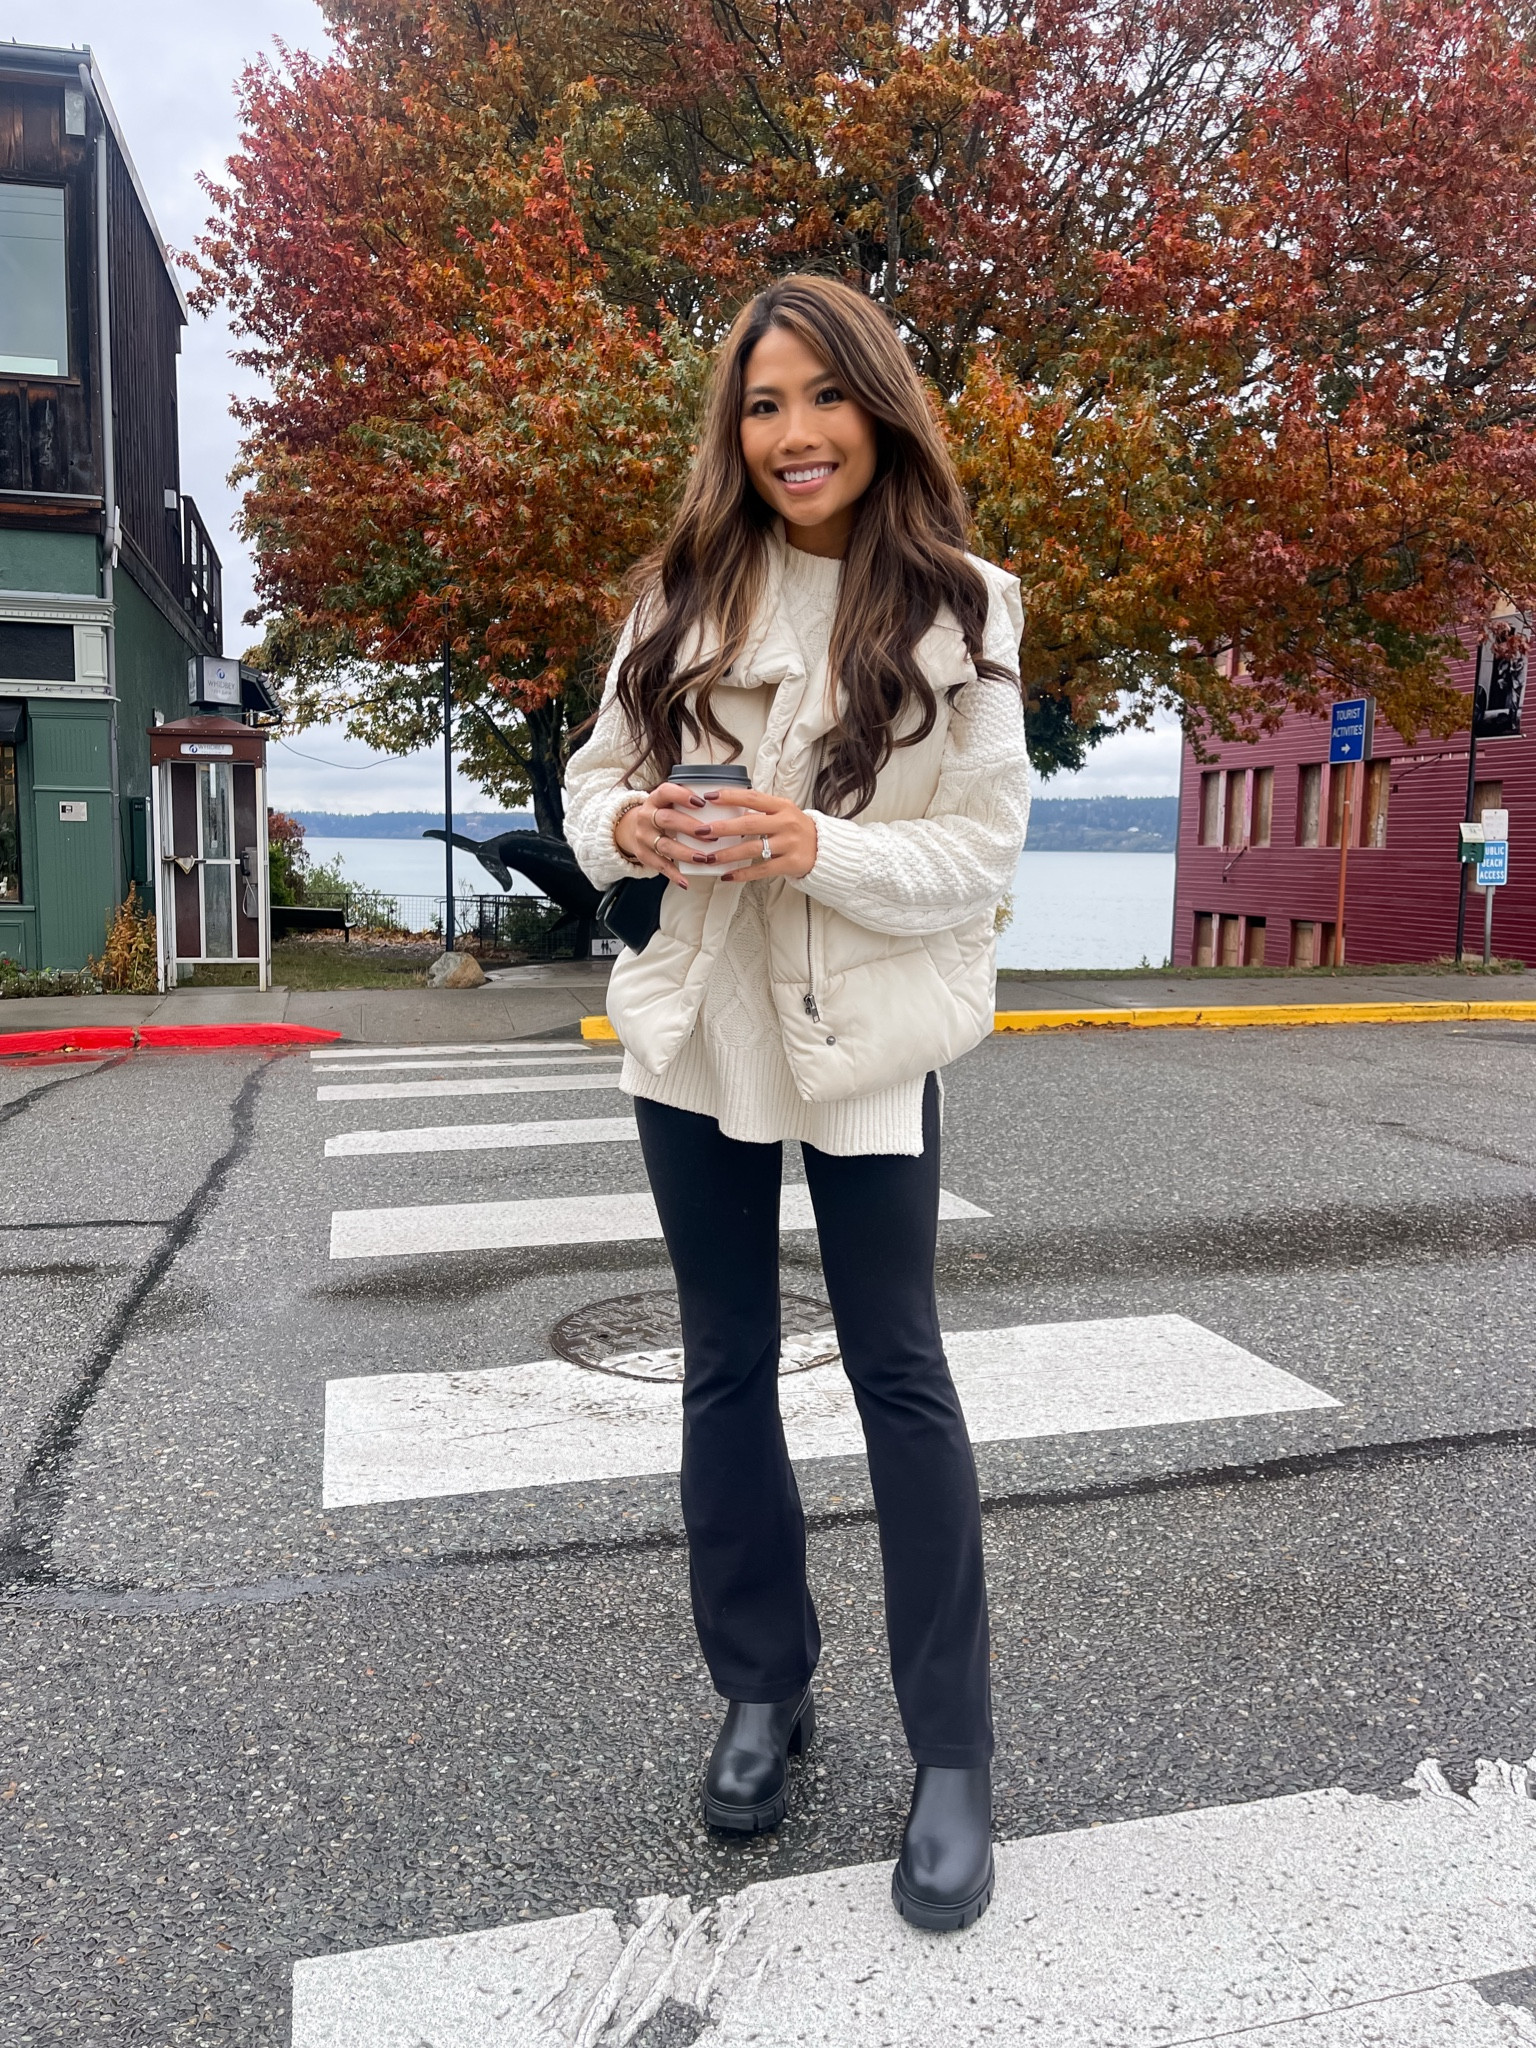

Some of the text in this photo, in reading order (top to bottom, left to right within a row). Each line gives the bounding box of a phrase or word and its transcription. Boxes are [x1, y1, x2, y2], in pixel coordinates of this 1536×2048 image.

[1336, 708, 1360, 720] TOURIST
[1332, 725, 1363, 737] ACTIVITIES
[1485, 847, 1504, 855] UBLIC
[1480, 871, 1504, 879] ACCESS
